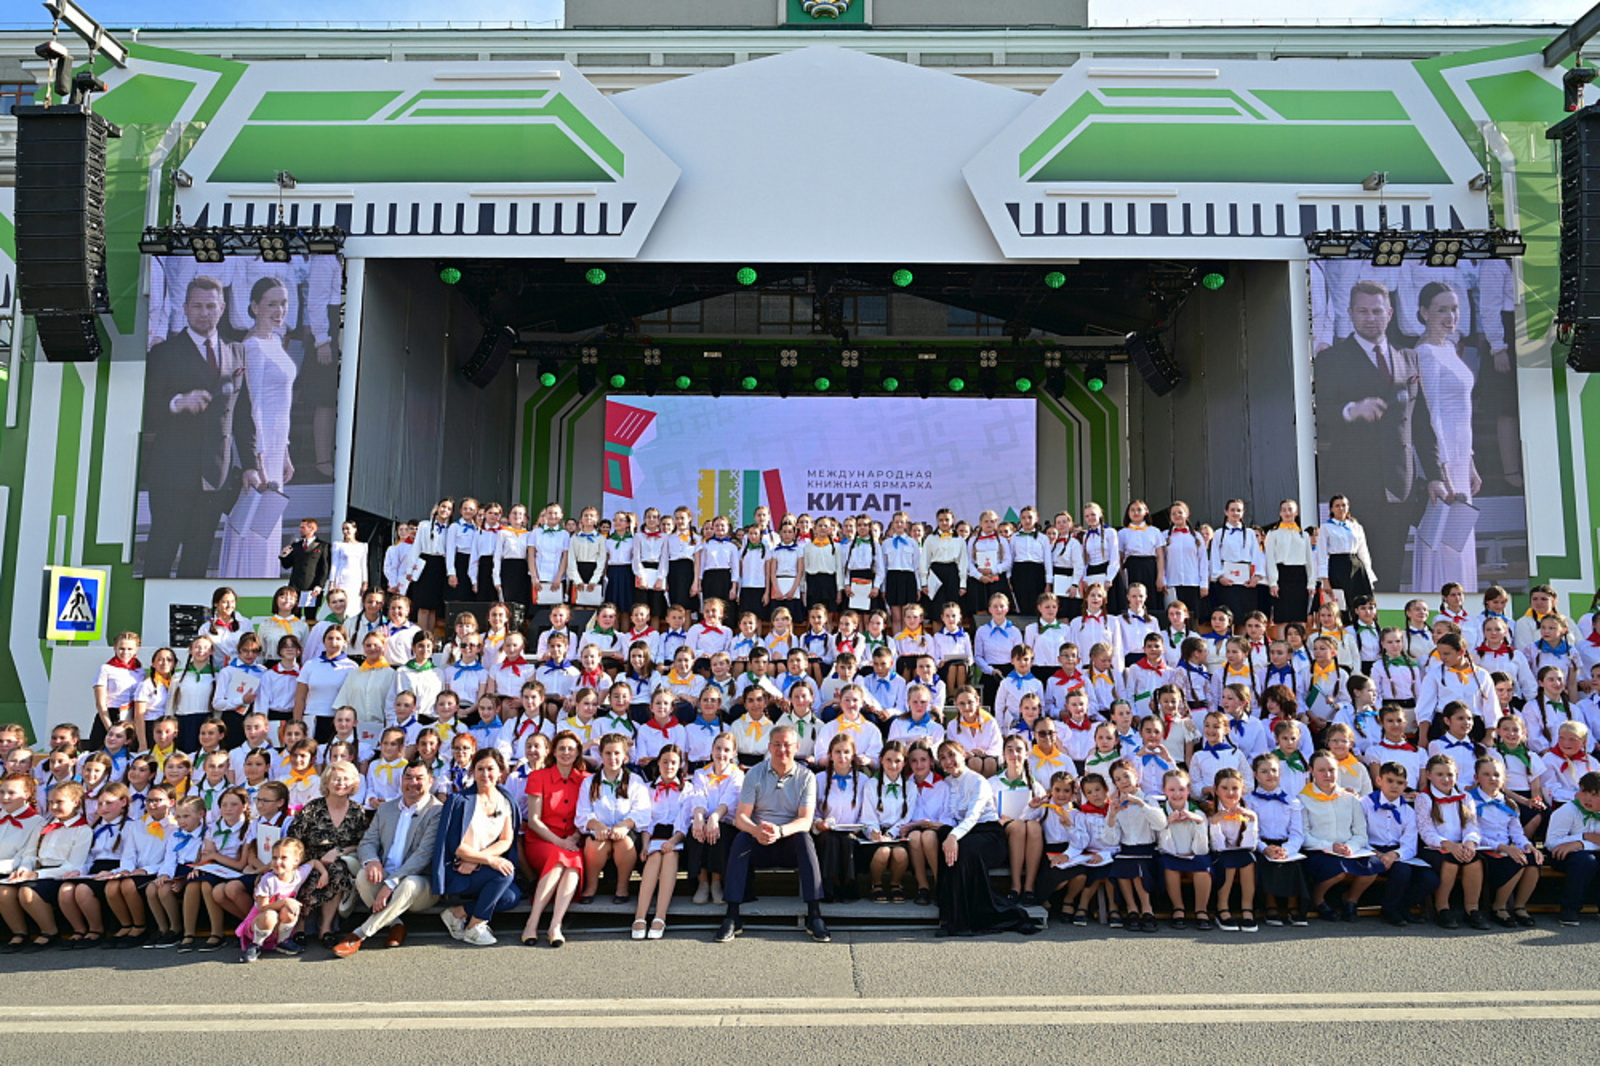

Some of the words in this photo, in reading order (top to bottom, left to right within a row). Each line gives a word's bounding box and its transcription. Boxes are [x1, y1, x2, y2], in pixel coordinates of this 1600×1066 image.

[807, 470, 933, 479] МЕЖДУНАРОДНАЯ
[807, 480, 868, 489] КНИЖНАЯ
[873, 481, 933, 489] ЯРМАРКА
[807, 493, 911, 511] КИТАП-
